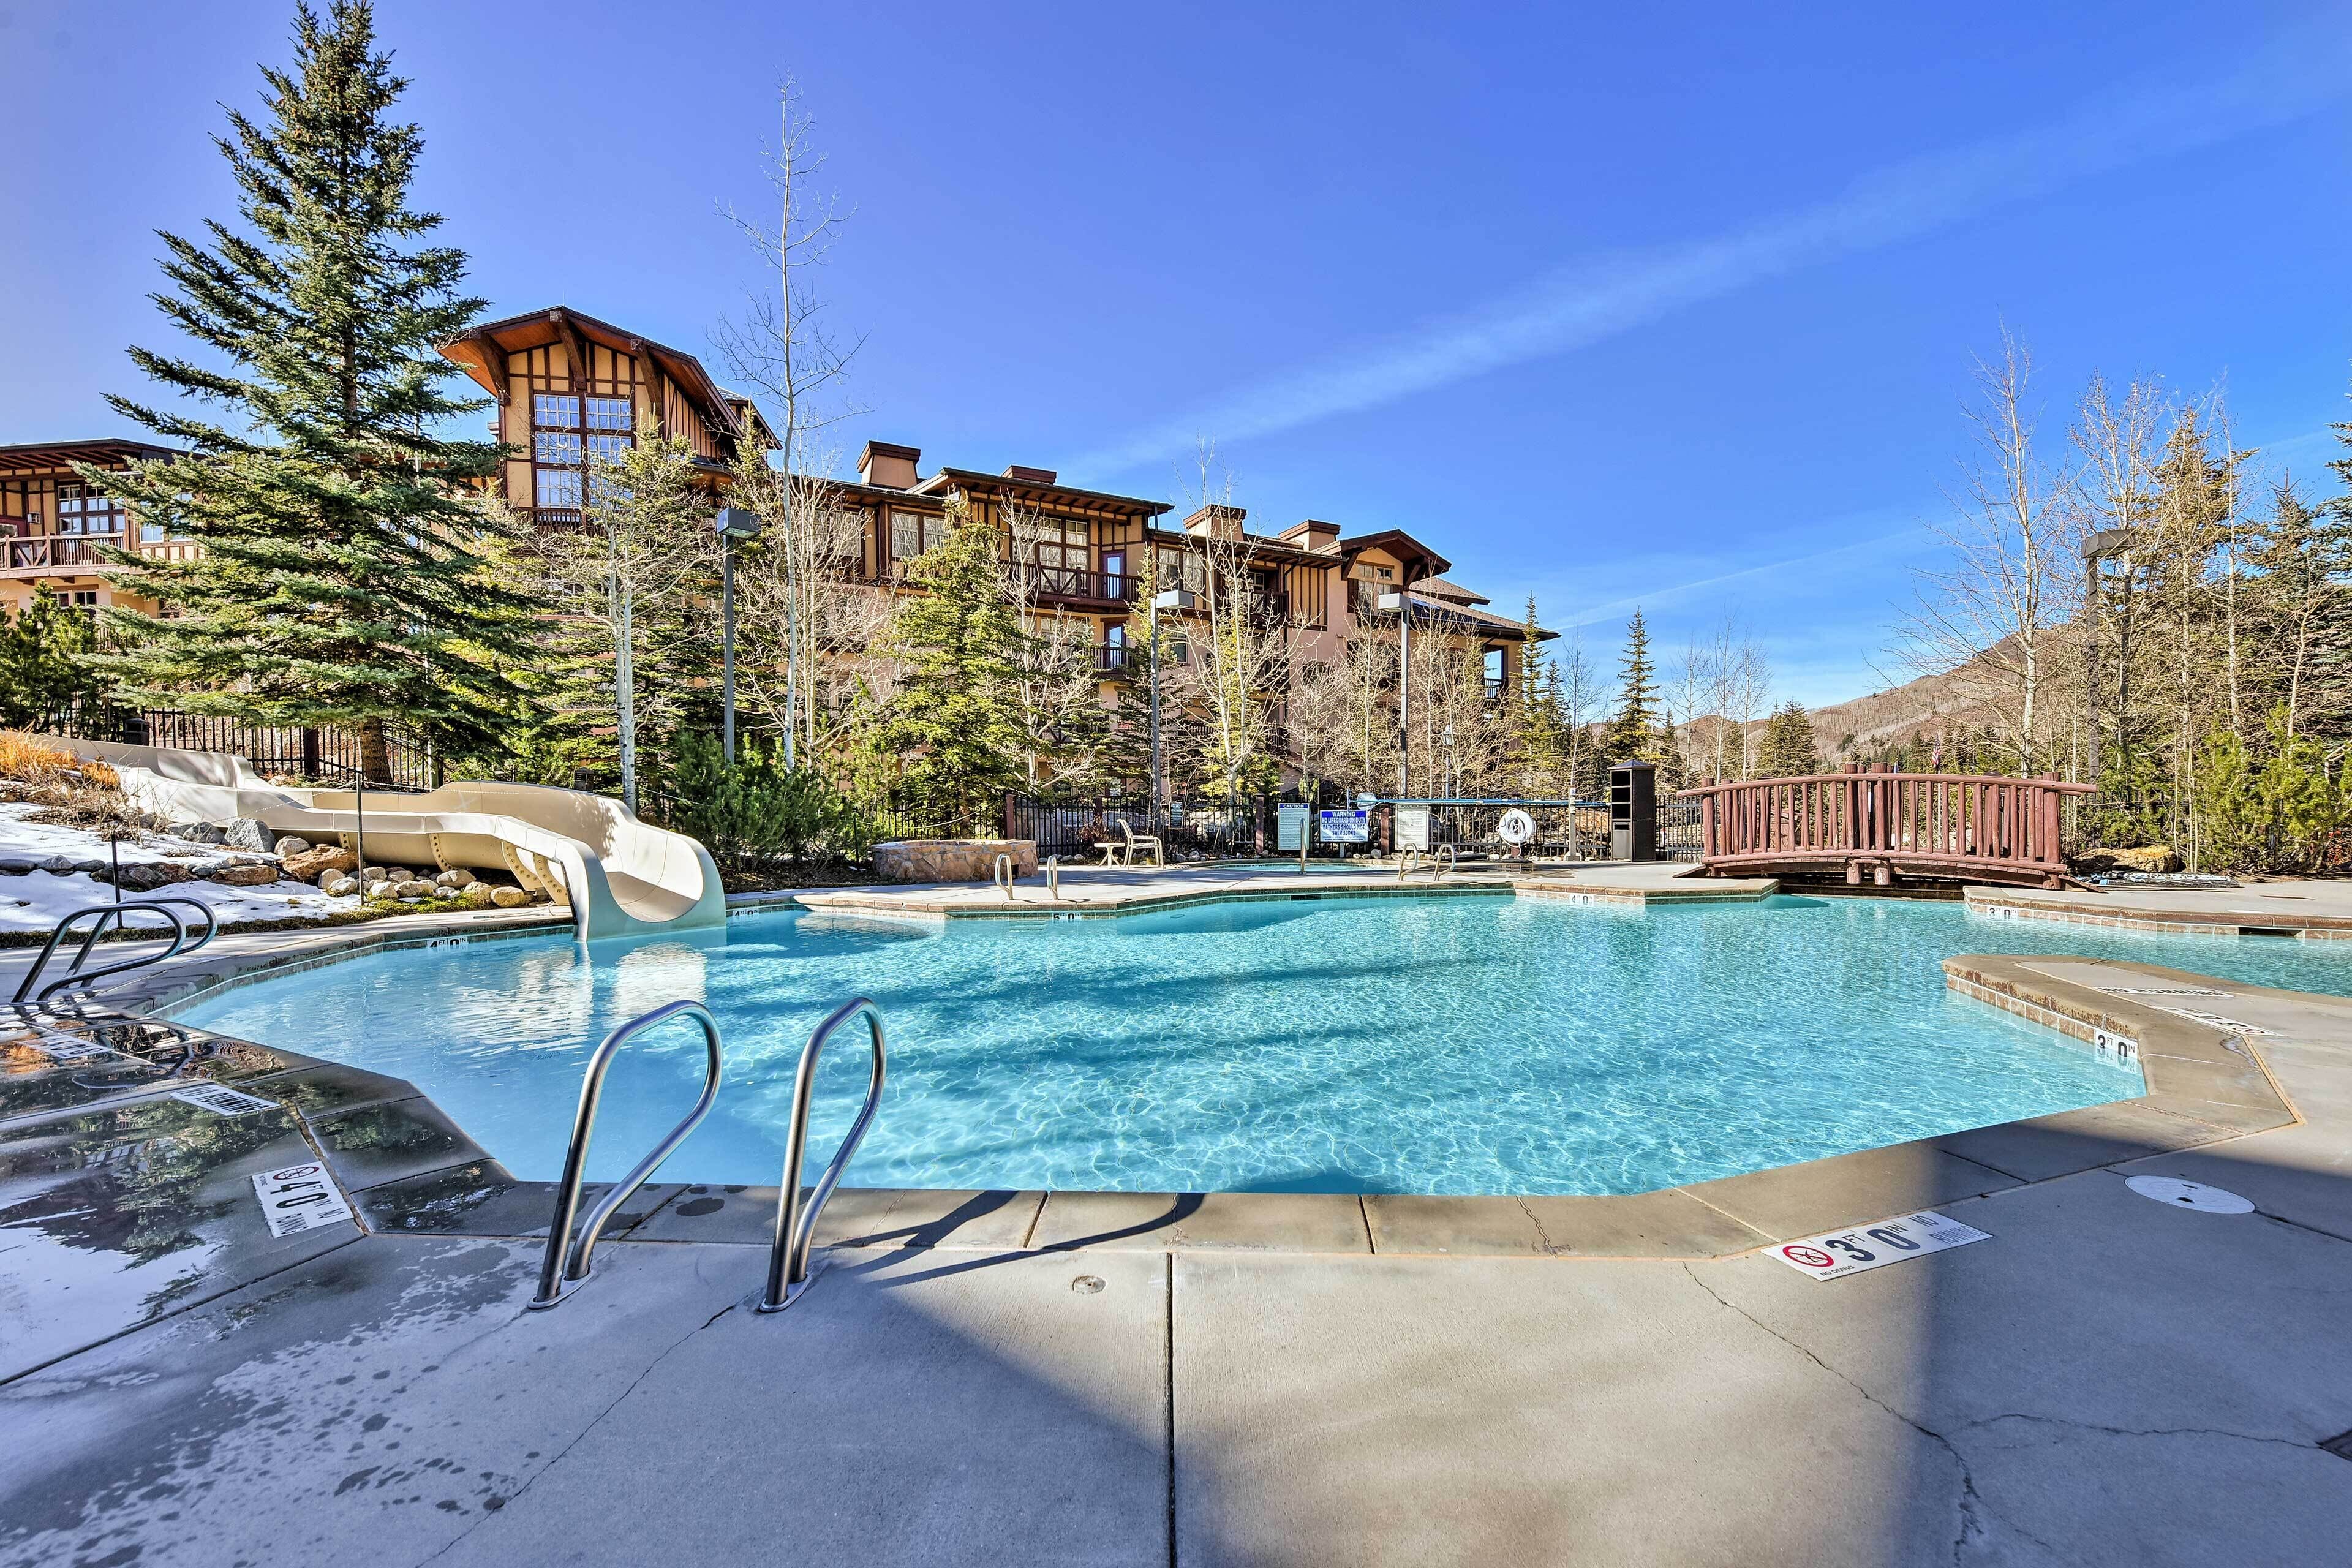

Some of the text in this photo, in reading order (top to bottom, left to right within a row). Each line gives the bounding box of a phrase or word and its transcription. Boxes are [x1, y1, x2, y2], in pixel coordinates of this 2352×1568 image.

[2098, 1034, 2135, 1058] 3 FT 0 IN
[177, 1086, 270, 1113] NO RUNNING
[270, 1181, 321, 1195] 4
[276, 1192, 329, 1208] 0
[314, 1197, 333, 1207] IN
[317, 1207, 345, 1219] NO
[1908, 1215, 1940, 1227] NO
[276, 1212, 309, 1235] RUNNING
[1825, 1224, 1921, 1262] 3 FT 0 IN
[1928, 1225, 1986, 1245] RUNNING
[1831, 1265, 1855, 1274] DIVING
